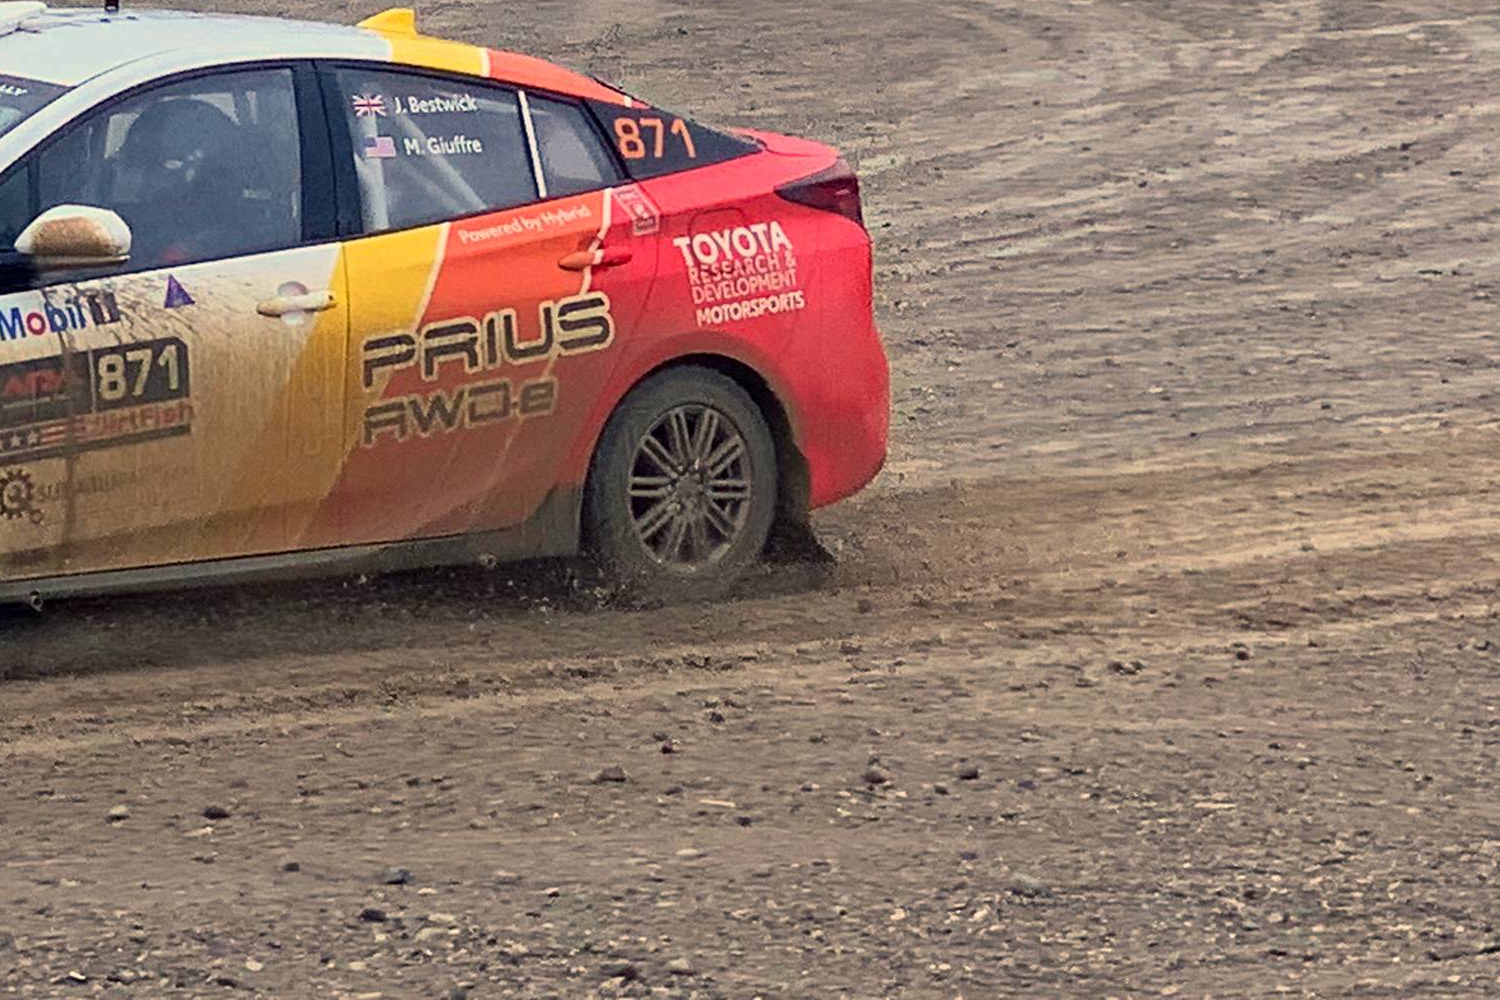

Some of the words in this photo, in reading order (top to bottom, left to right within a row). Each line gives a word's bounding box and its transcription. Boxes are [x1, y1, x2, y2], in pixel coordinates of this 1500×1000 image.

[394, 96, 408, 115] J.
[410, 94, 478, 114] Bestwick
[404, 138, 423, 156] M.
[426, 136, 483, 155] Giuffre
[613, 117, 696, 159] 871
[457, 220, 518, 245] Powered
[520, 216, 541, 238] by
[542, 203, 592, 230] Hybrid
[673, 220, 794, 267] TOYOTA
[688, 252, 782, 286] RESEARCH
[785, 250, 797, 268] &
[691, 268, 797, 305] DEVELOPMENT
[695, 290, 805, 327] MOTORSPORTS
[360, 292, 614, 391] PRIUS
[98, 344, 180, 401] 871
